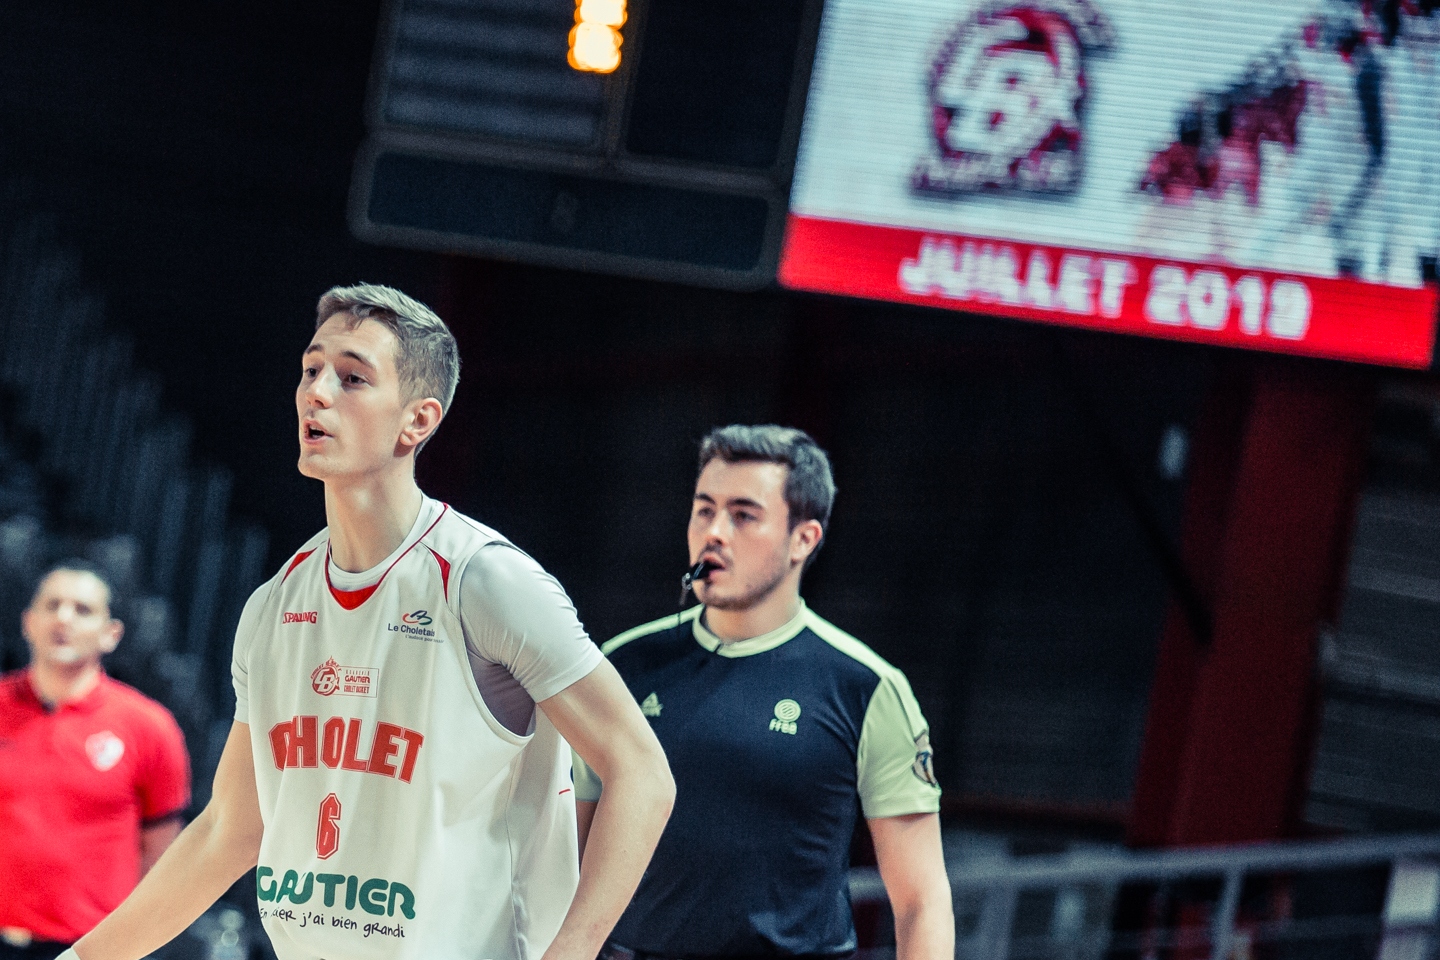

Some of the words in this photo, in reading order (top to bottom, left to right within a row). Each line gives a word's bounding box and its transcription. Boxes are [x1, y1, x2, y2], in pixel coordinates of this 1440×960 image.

[387, 622, 399, 632] Le
[316, 792, 342, 860] 6
[256, 865, 417, 920] GAUTIER
[299, 911, 325, 928] j'ai
[331, 916, 358, 930] bien
